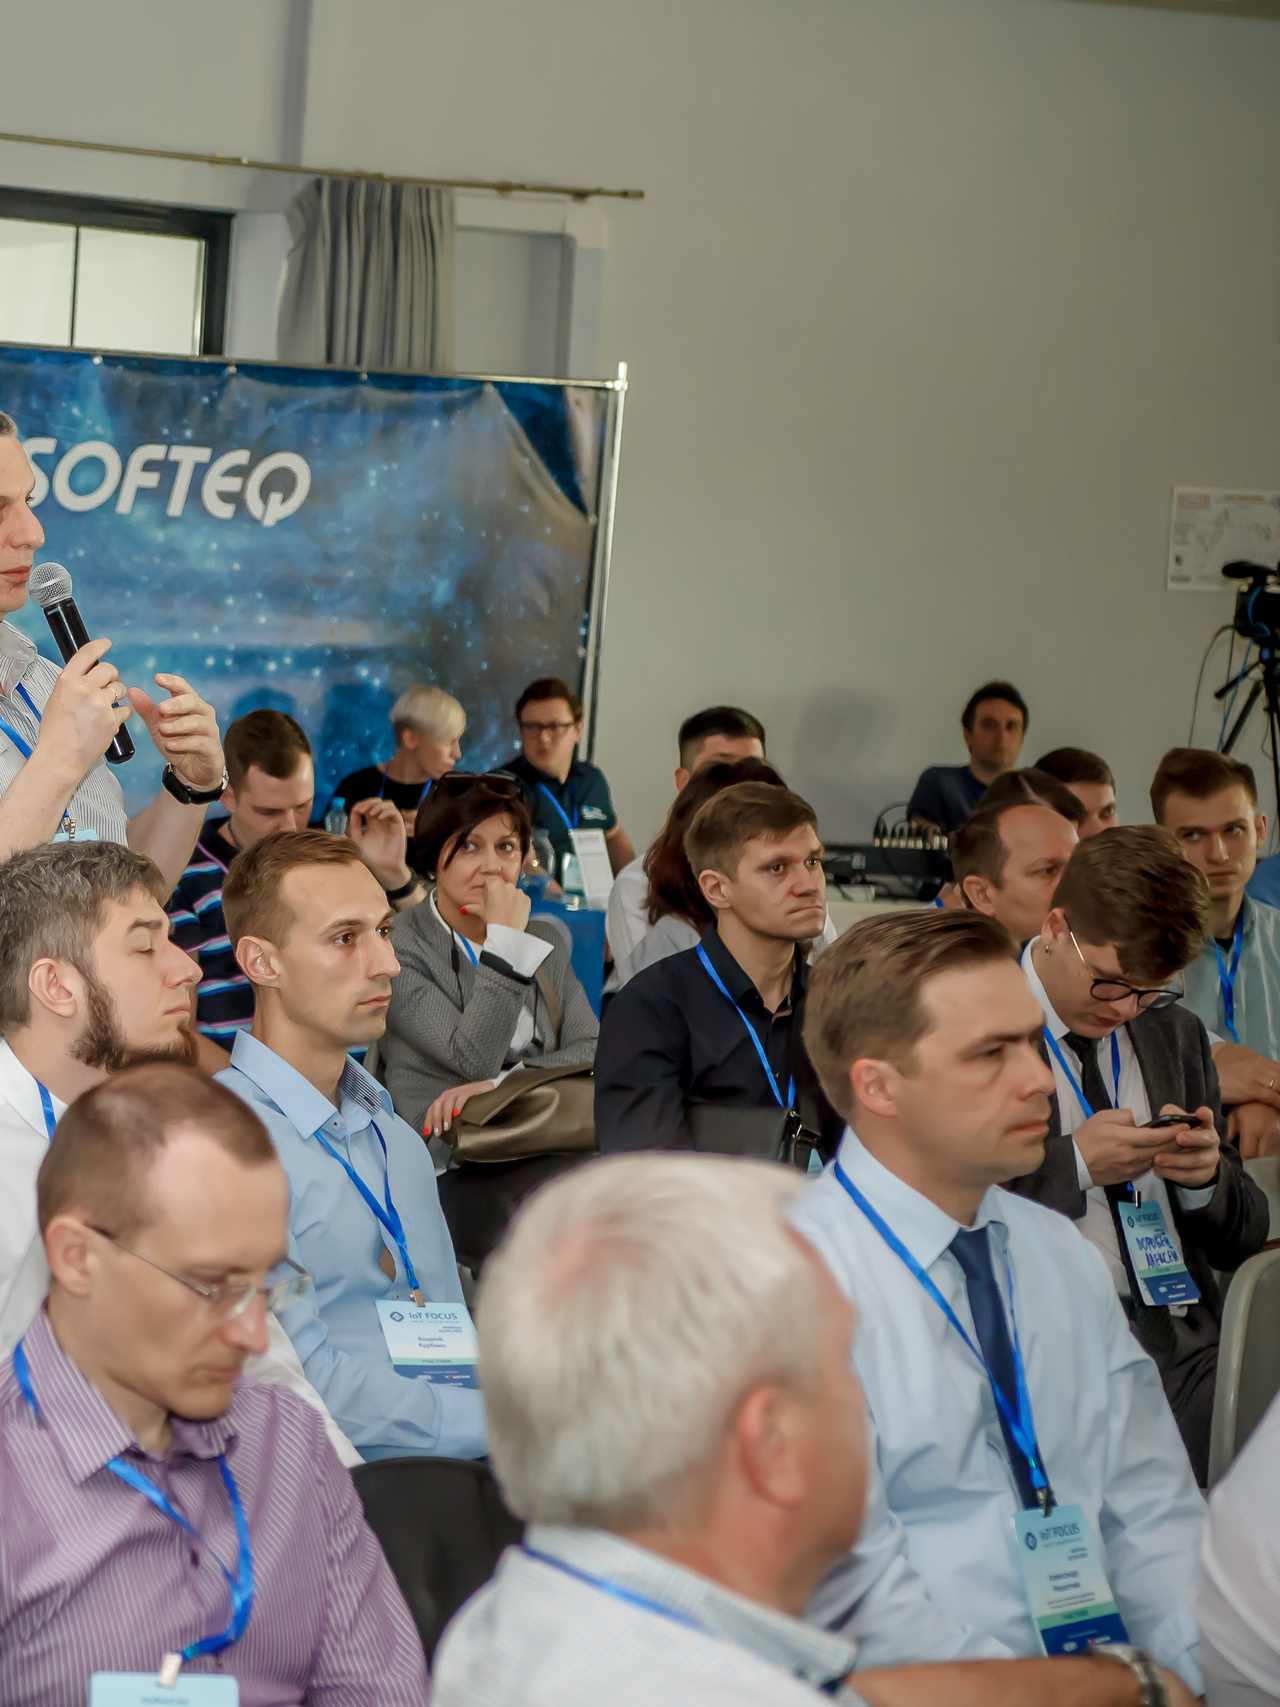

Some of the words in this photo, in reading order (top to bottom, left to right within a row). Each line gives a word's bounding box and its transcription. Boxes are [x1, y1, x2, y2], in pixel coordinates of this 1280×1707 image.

[21, 436, 312, 527] SOFTEQ
[425, 1312, 458, 1320] FOCUS
[1053, 1523, 1081, 1538] FOCUS
